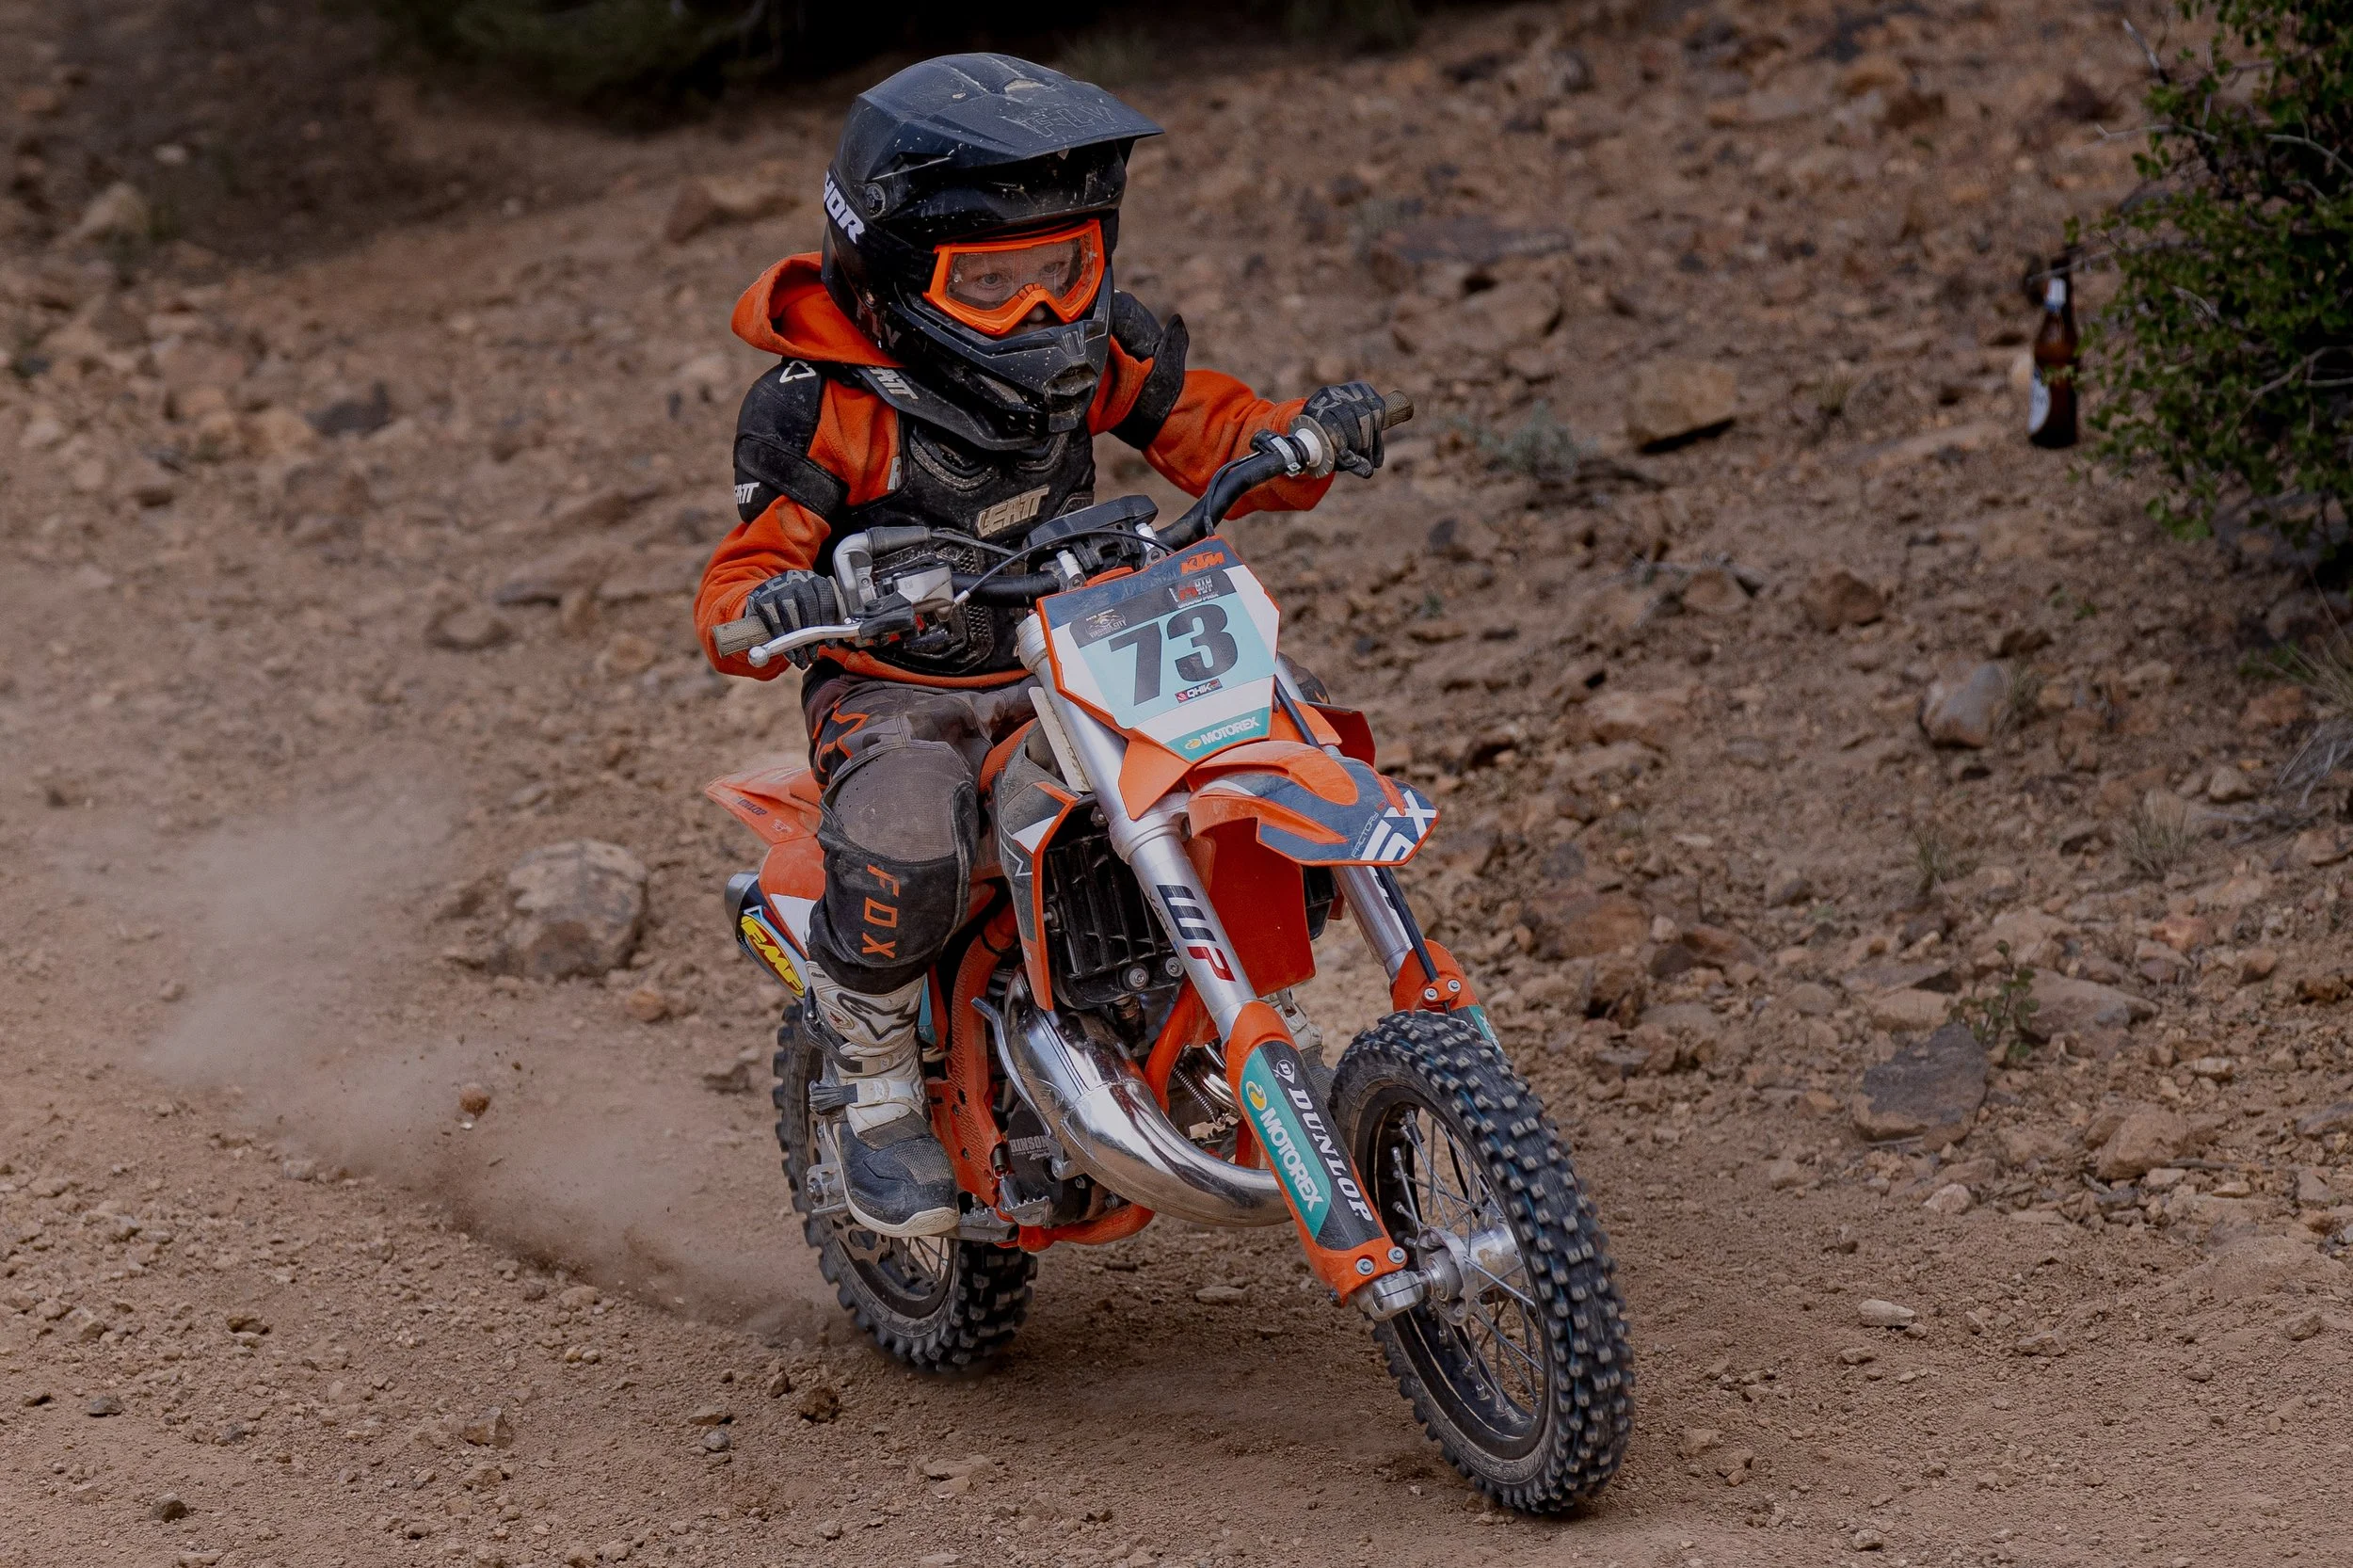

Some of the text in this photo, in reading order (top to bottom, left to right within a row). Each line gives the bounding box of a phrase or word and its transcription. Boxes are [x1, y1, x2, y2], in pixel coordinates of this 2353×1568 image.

[824, 170, 865, 245] HOR
[977, 486, 1049, 537] LEATT
[1180, 552, 1225, 575] KTM
[1109, 603, 1239, 706] 73
[1199, 716, 1259, 745] MOTOREX
[1351, 811, 1380, 858] FACTORY
[862, 864, 900, 959] FOX
[1156, 885, 1236, 982] WP
[741, 920, 806, 991] FMF
[1259, 1106, 1323, 1212] MOTOREX
[1288, 1087, 1373, 1222] DUNLOP
